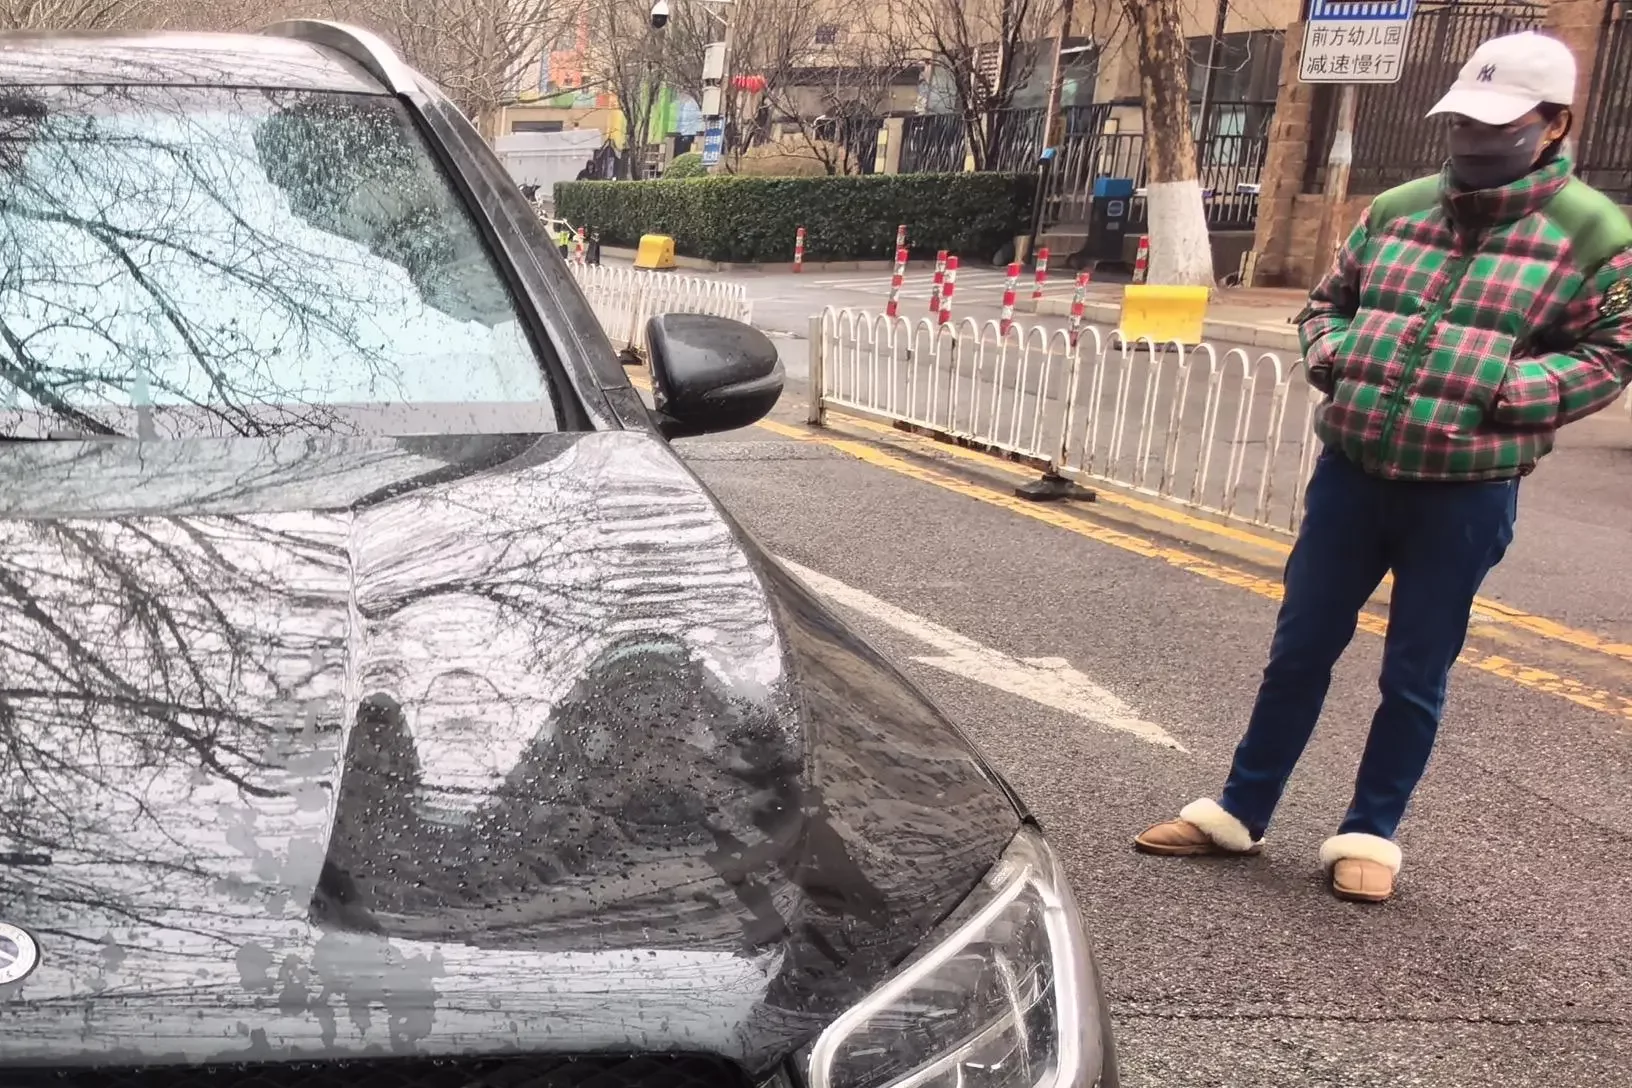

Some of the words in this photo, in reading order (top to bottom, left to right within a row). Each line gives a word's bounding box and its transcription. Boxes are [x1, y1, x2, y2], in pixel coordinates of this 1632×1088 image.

[1311, 25, 1402, 47] 前方幼儿园
[1306, 53, 1397, 75] 减速慢行
